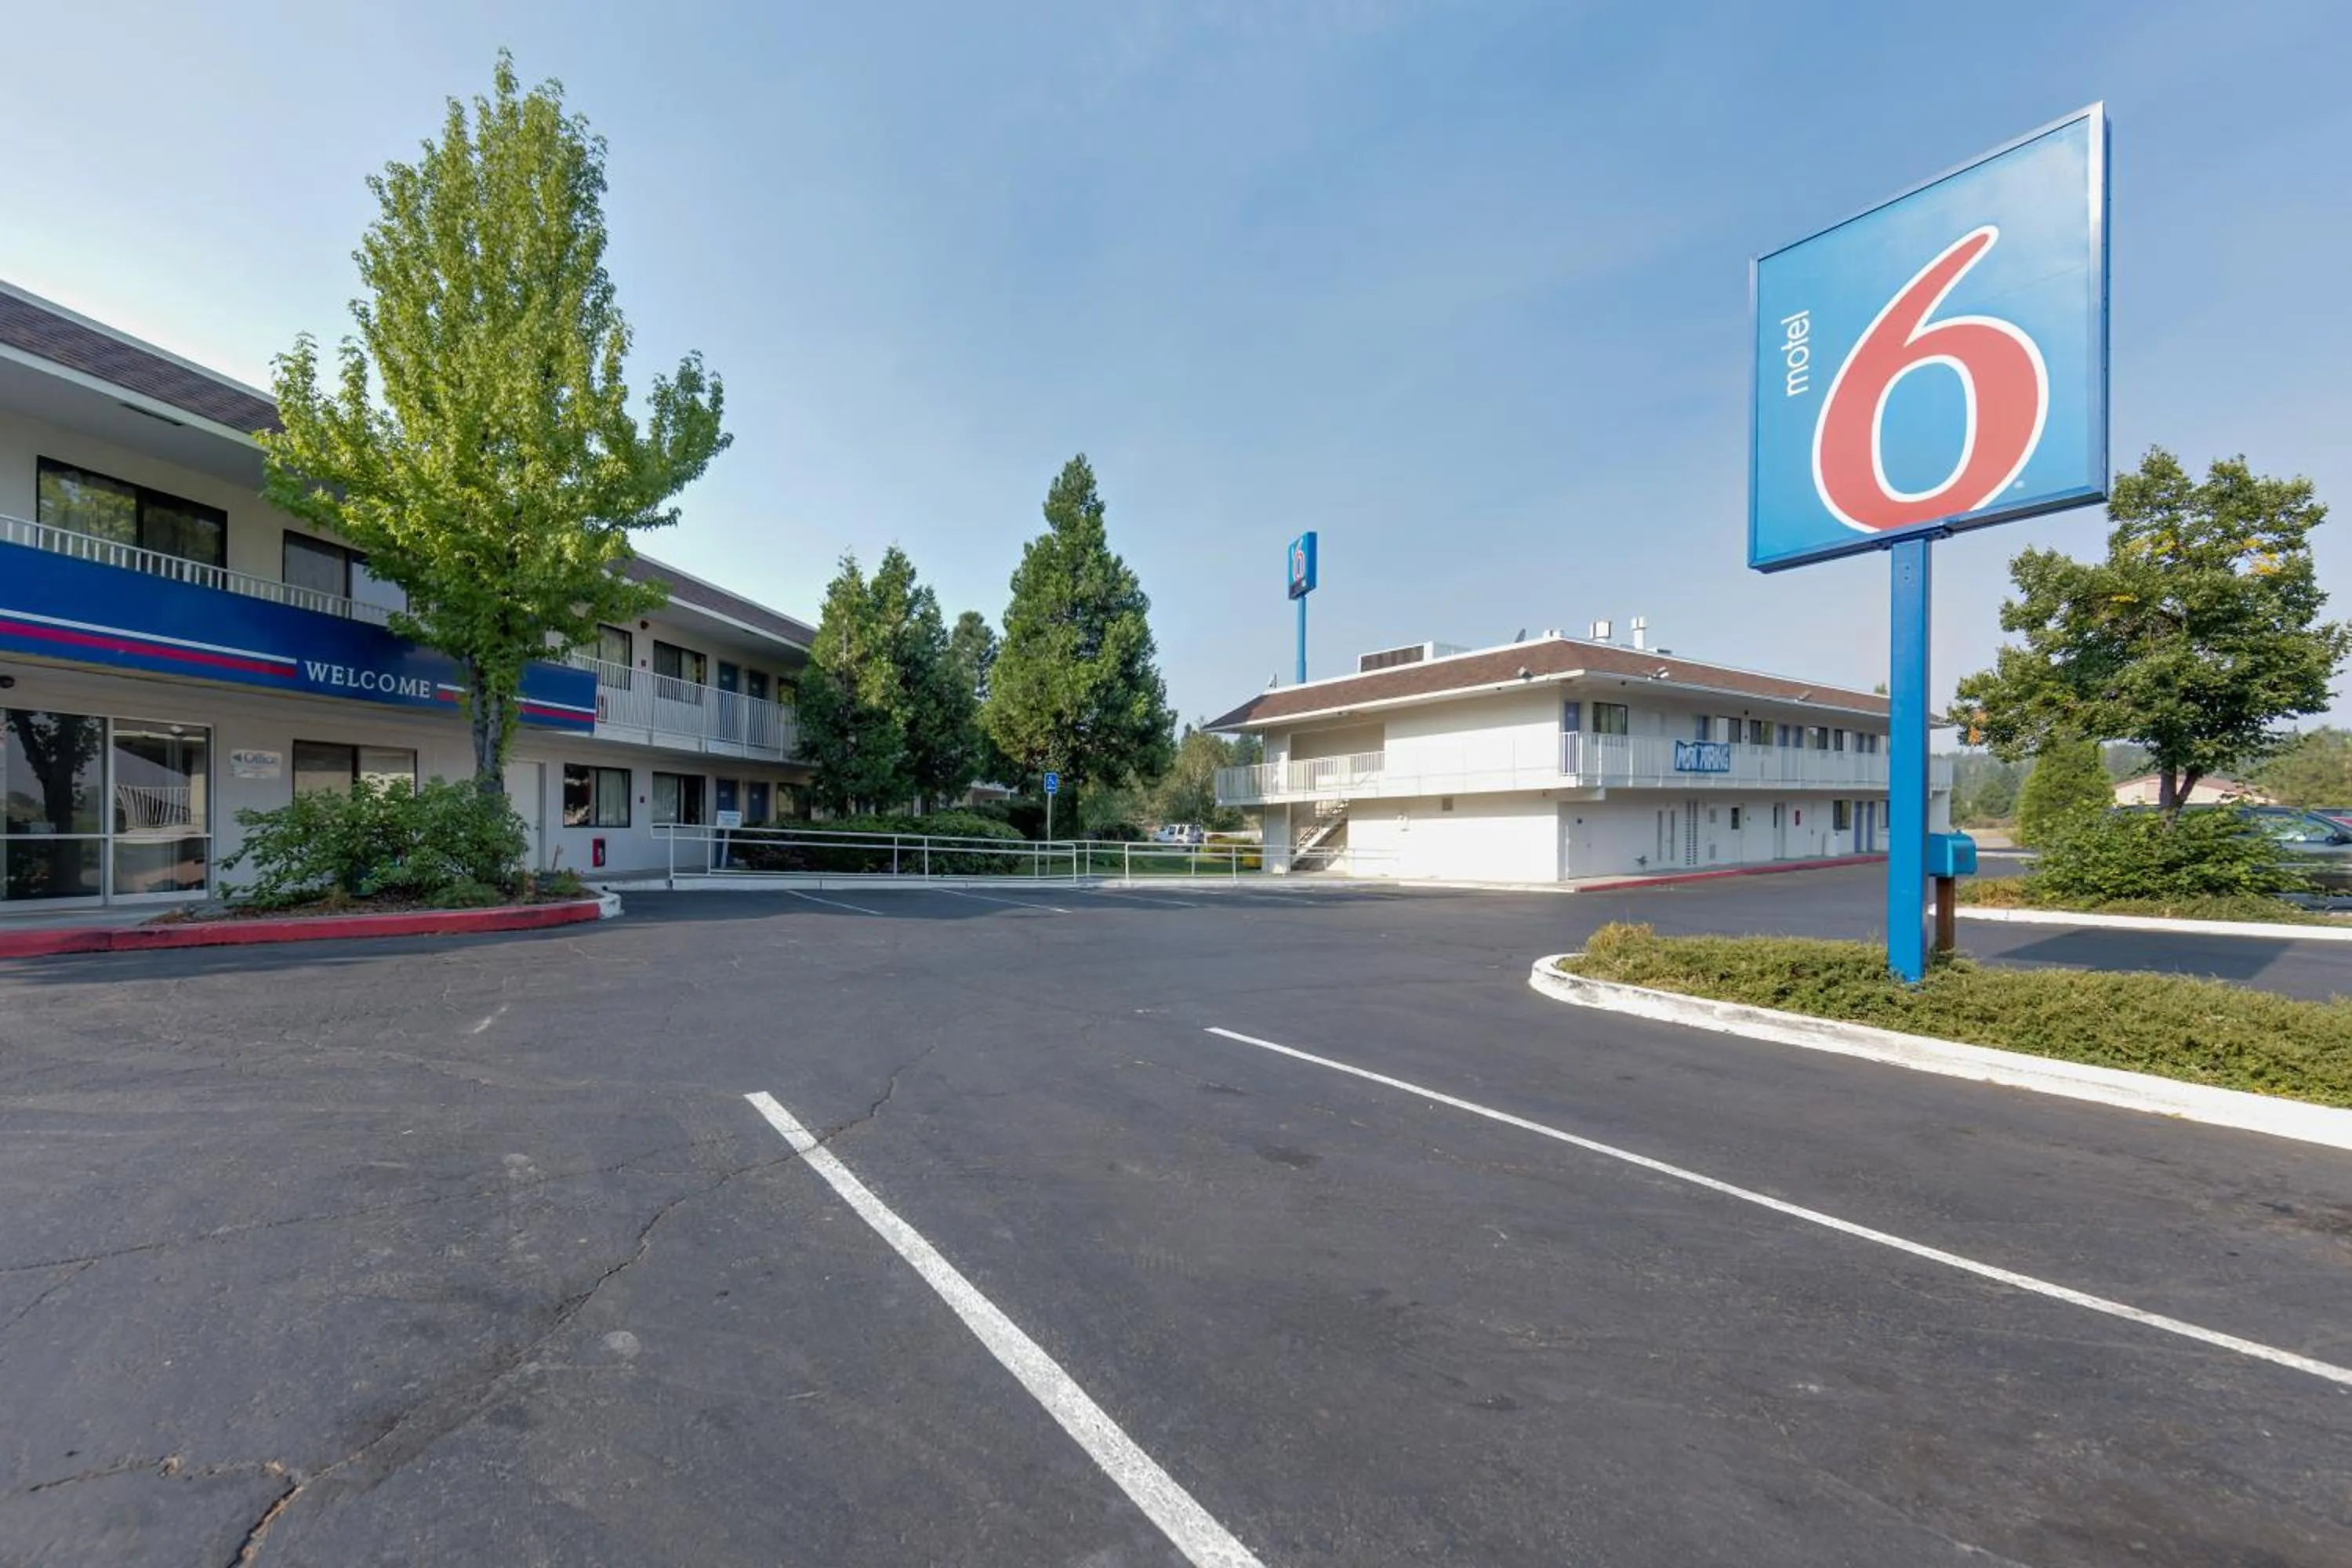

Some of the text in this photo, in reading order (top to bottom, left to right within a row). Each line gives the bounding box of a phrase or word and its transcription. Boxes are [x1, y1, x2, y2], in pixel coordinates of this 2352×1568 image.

[1781, 310, 1809, 396] motel
[1812, 225, 2049, 534] 6
[1292, 539, 1305, 583] 6
[304, 660, 430, 699] WELCOME
